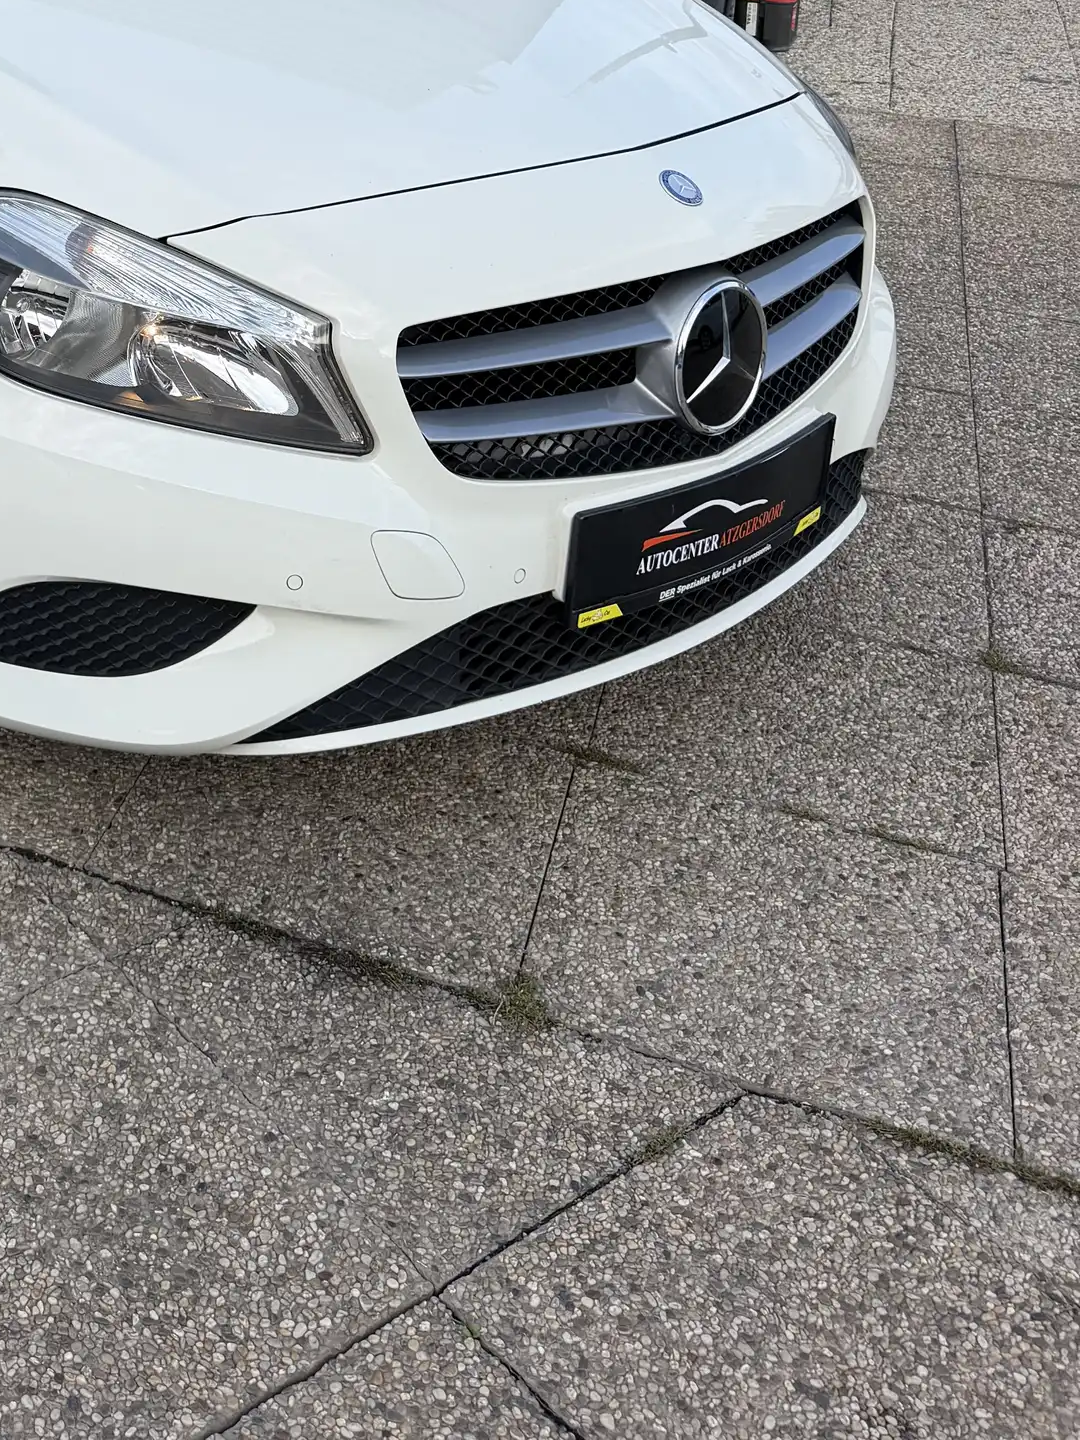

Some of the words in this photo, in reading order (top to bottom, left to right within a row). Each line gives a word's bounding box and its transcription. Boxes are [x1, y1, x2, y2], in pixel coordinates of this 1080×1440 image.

[636, 533, 719, 575] AUTOCENTER
[719, 499, 786, 548] ATZGERSDORF
[659, 587, 676, 601] DER
[676, 574, 711, 594] Spezialist
